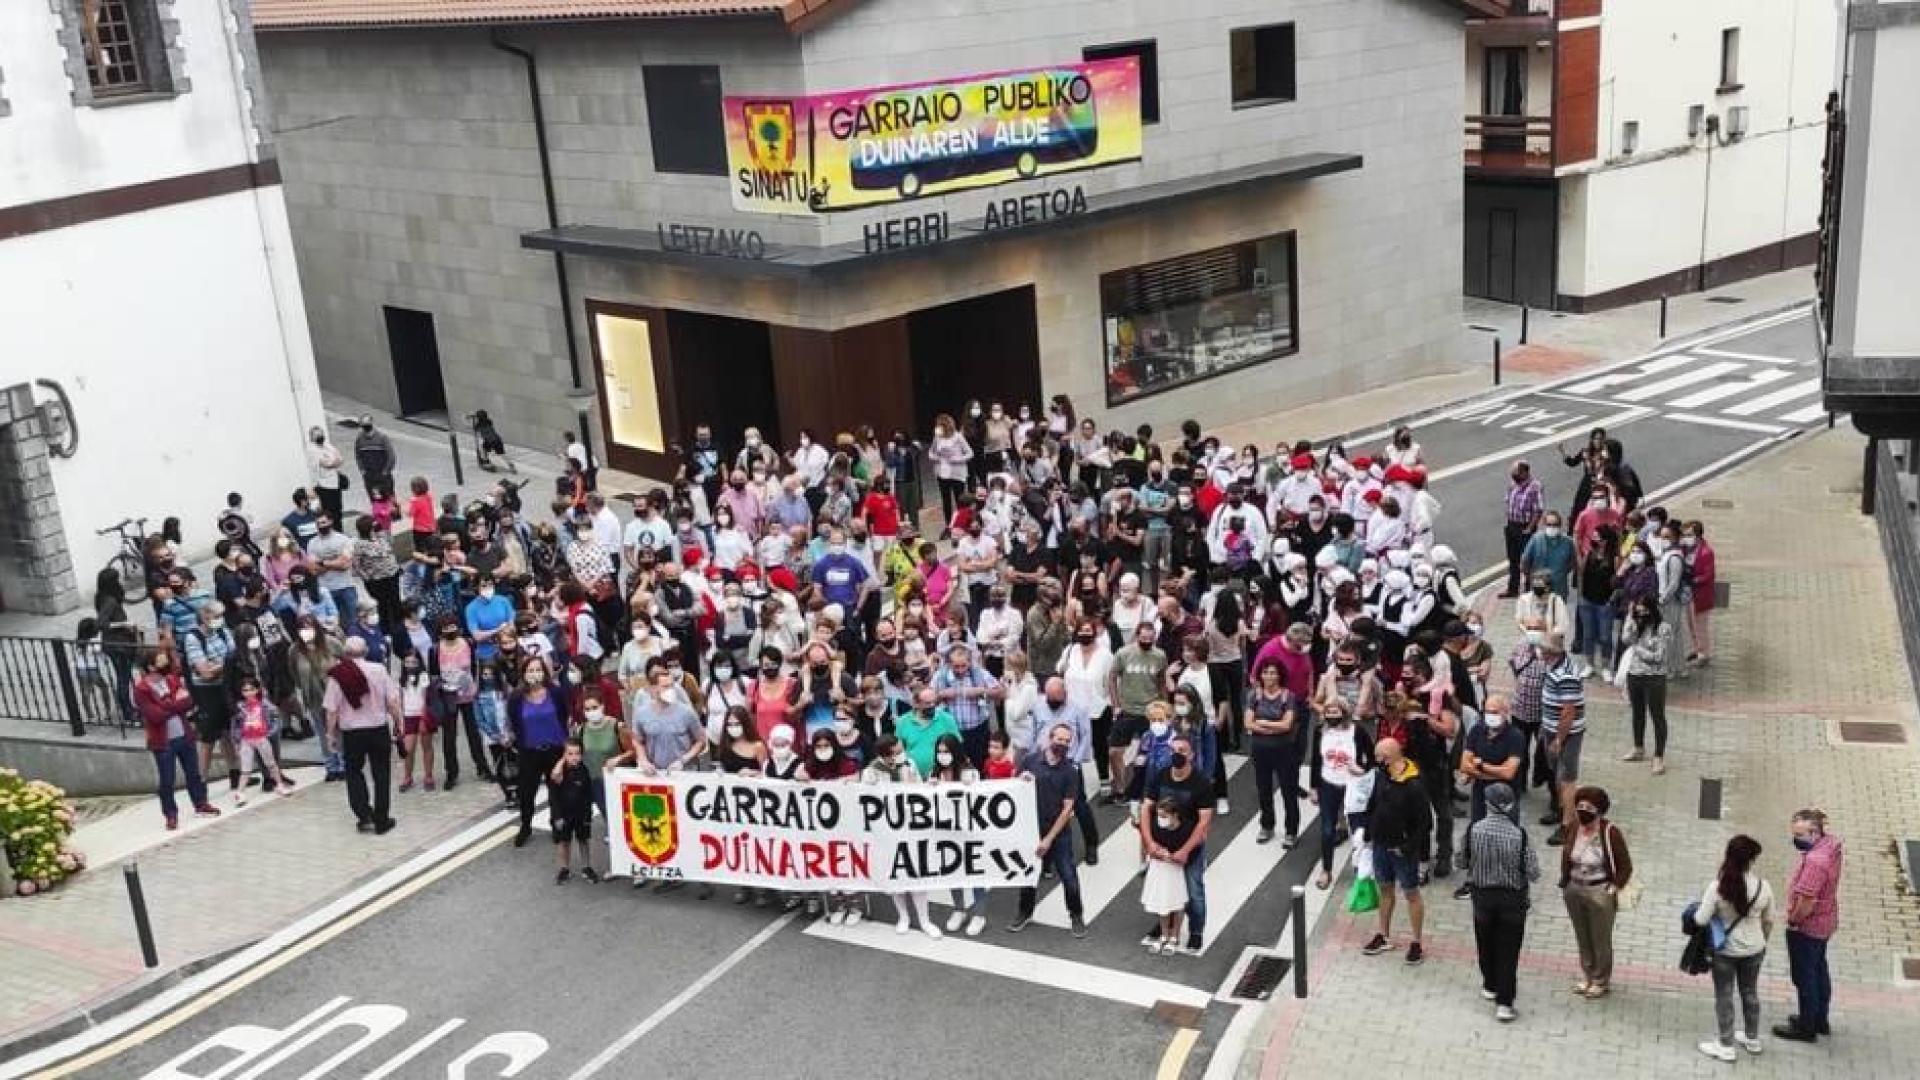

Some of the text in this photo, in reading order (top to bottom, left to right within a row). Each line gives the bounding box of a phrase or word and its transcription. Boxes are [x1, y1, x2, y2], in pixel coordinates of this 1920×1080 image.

[829, 75, 1092, 140] GARRAIO PUBLIKO
[860, 116, 1051, 167] DUINAREN ALDE
[863, 186, 1088, 254] HERRI ARETOA
[858, 790, 1016, 832] PUBLIKO
